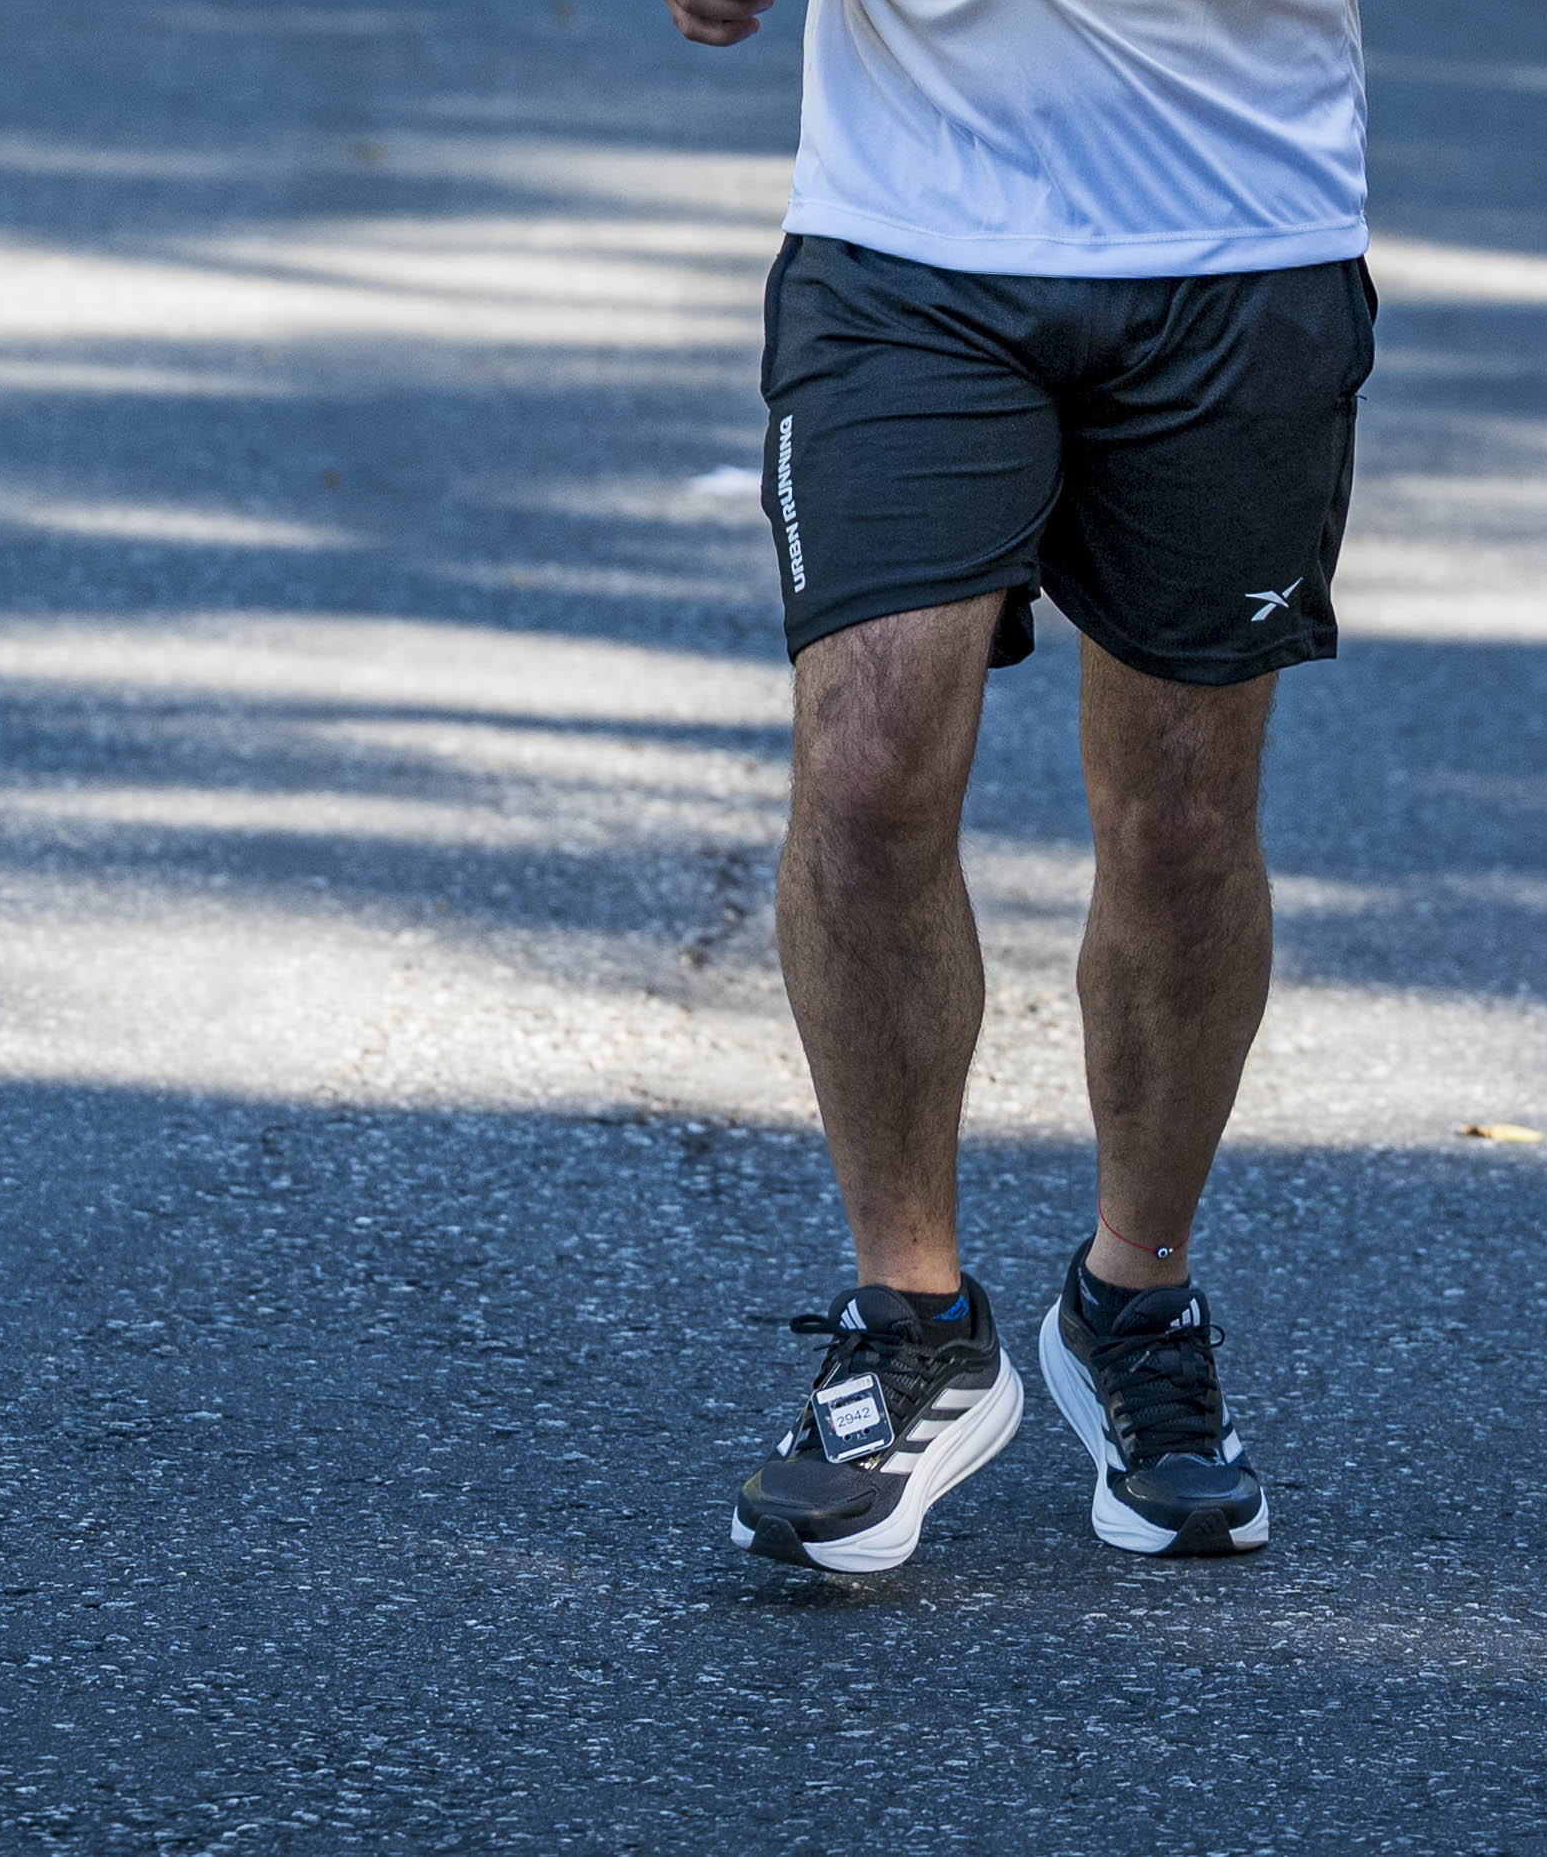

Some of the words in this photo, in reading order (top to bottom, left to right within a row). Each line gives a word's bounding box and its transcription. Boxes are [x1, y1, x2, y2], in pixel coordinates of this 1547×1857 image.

[777, 414, 797, 522] RUNNING
[785, 522, 806, 593] URBN
[836, 1407, 872, 1428] 2942
